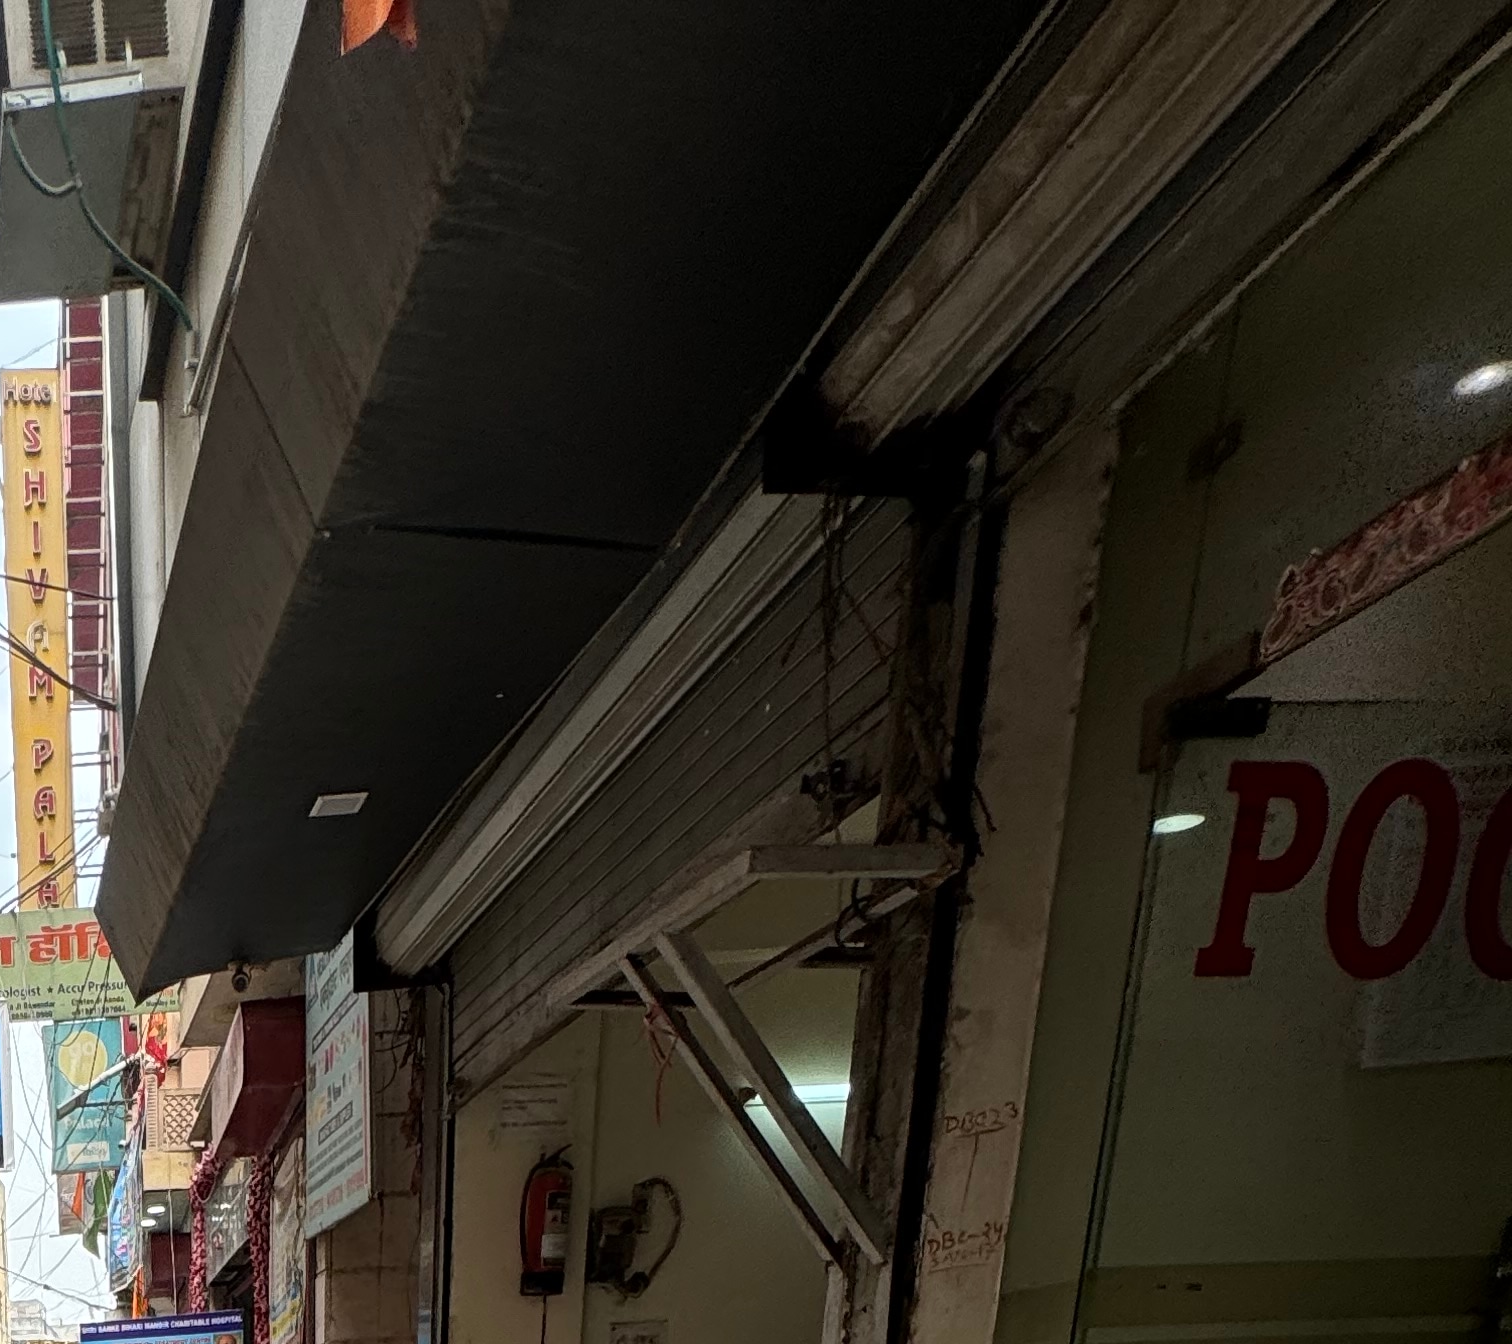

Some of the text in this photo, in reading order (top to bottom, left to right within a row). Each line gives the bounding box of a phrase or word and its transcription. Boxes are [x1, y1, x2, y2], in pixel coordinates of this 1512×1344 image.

[3, 376, 56, 403] Hotel
[23, 419, 55, 698] SHIVAM
[211, 1315, 243, 1326] HOSPITAL
